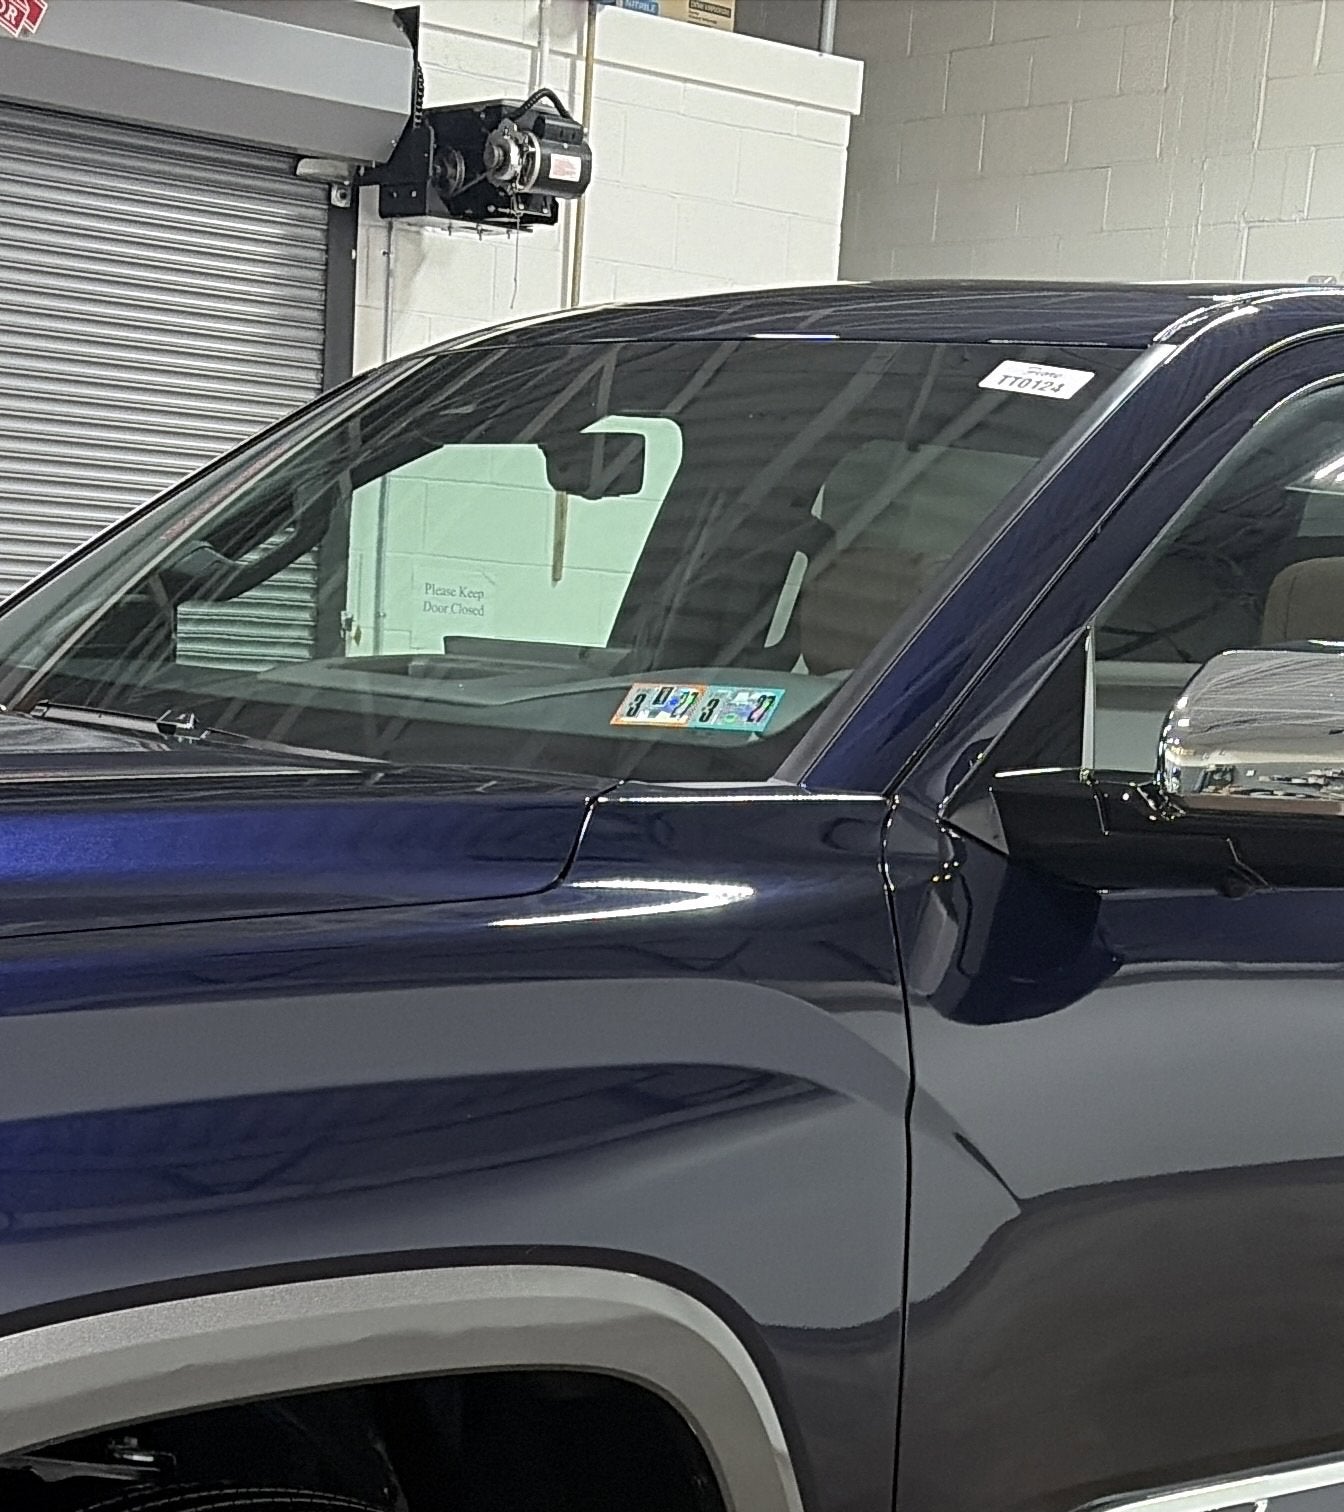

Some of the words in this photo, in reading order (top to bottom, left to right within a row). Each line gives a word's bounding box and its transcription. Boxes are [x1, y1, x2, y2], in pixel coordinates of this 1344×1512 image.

[424, 582, 456, 597] Please
[459, 586, 484, 601] Keep
[422, 600, 449, 614] Door
[451, 602, 484, 616] Closed
[699, 698, 720, 723] 3
